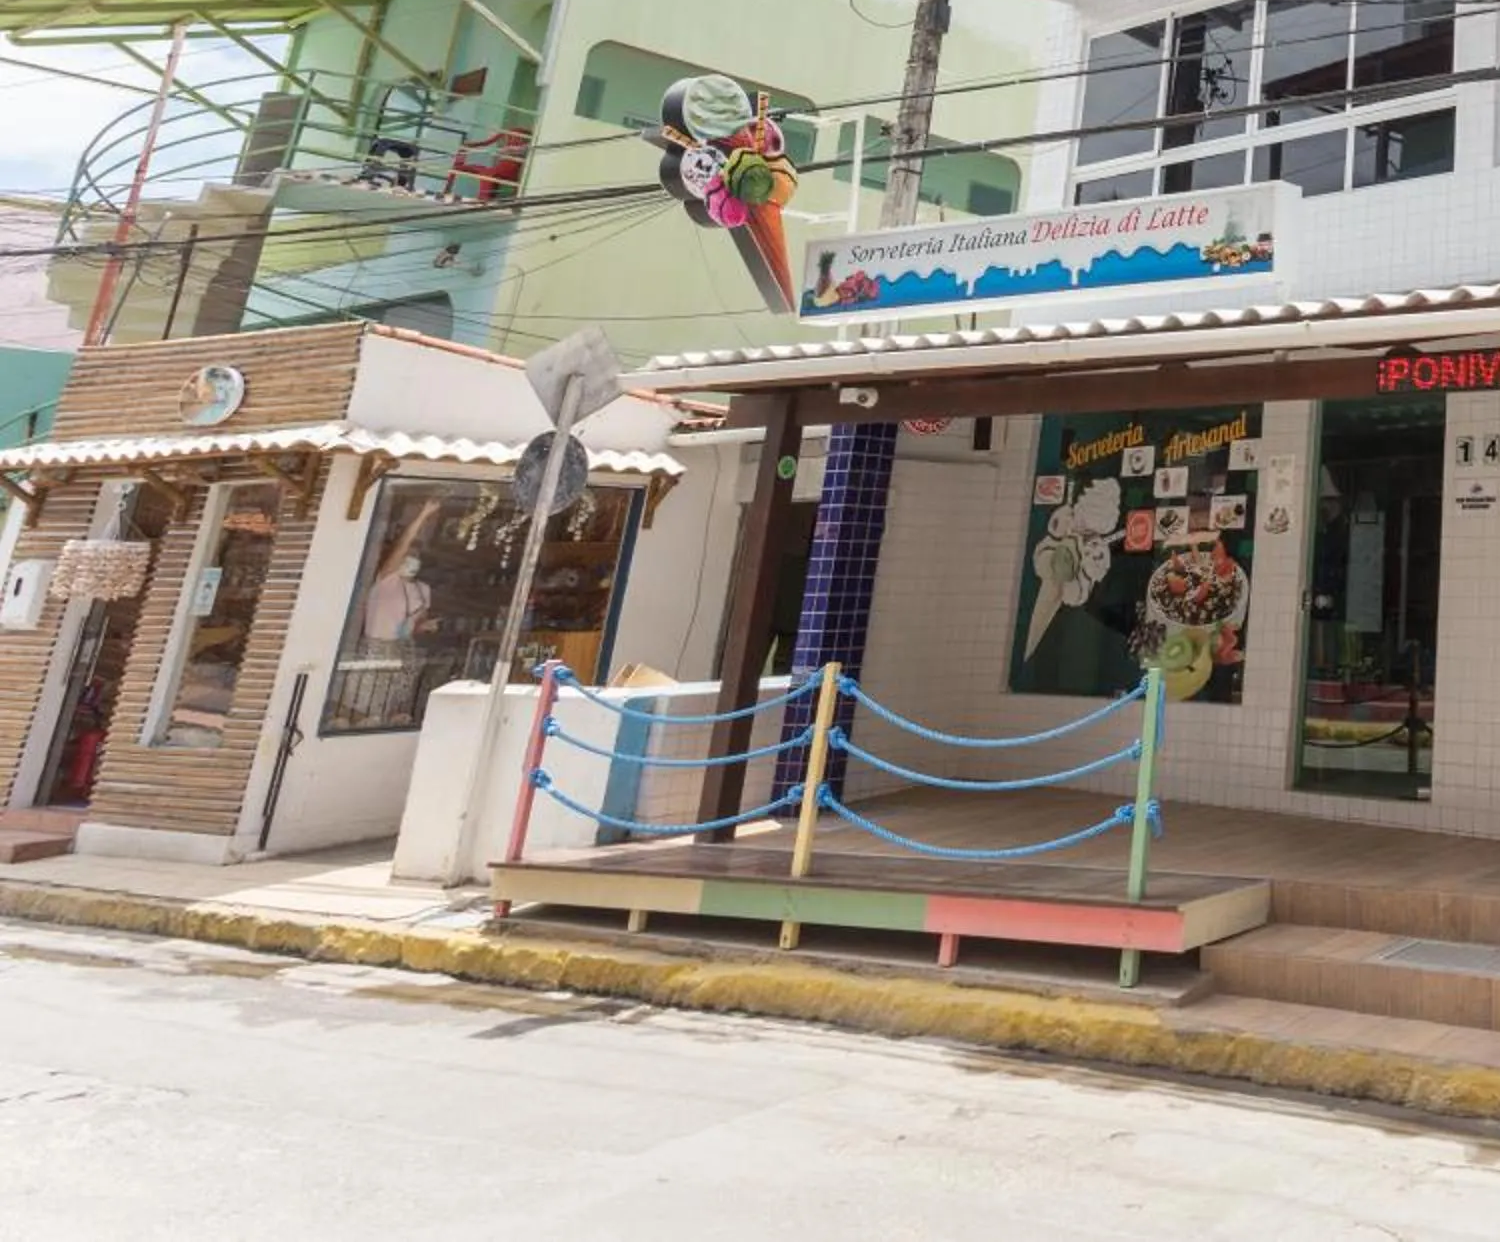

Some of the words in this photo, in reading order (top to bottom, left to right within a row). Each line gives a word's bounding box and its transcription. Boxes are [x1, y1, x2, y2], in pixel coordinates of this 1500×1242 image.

[848, 237, 944, 264] Sorveteria
[948, 227, 1028, 253] Italiana
[1031, 214, 1111, 244] Delizia
[1145, 206, 1209, 231] Latte
[1066, 422, 1144, 469] Sorveteria
[1165, 411, 1247, 466] Artesanal
